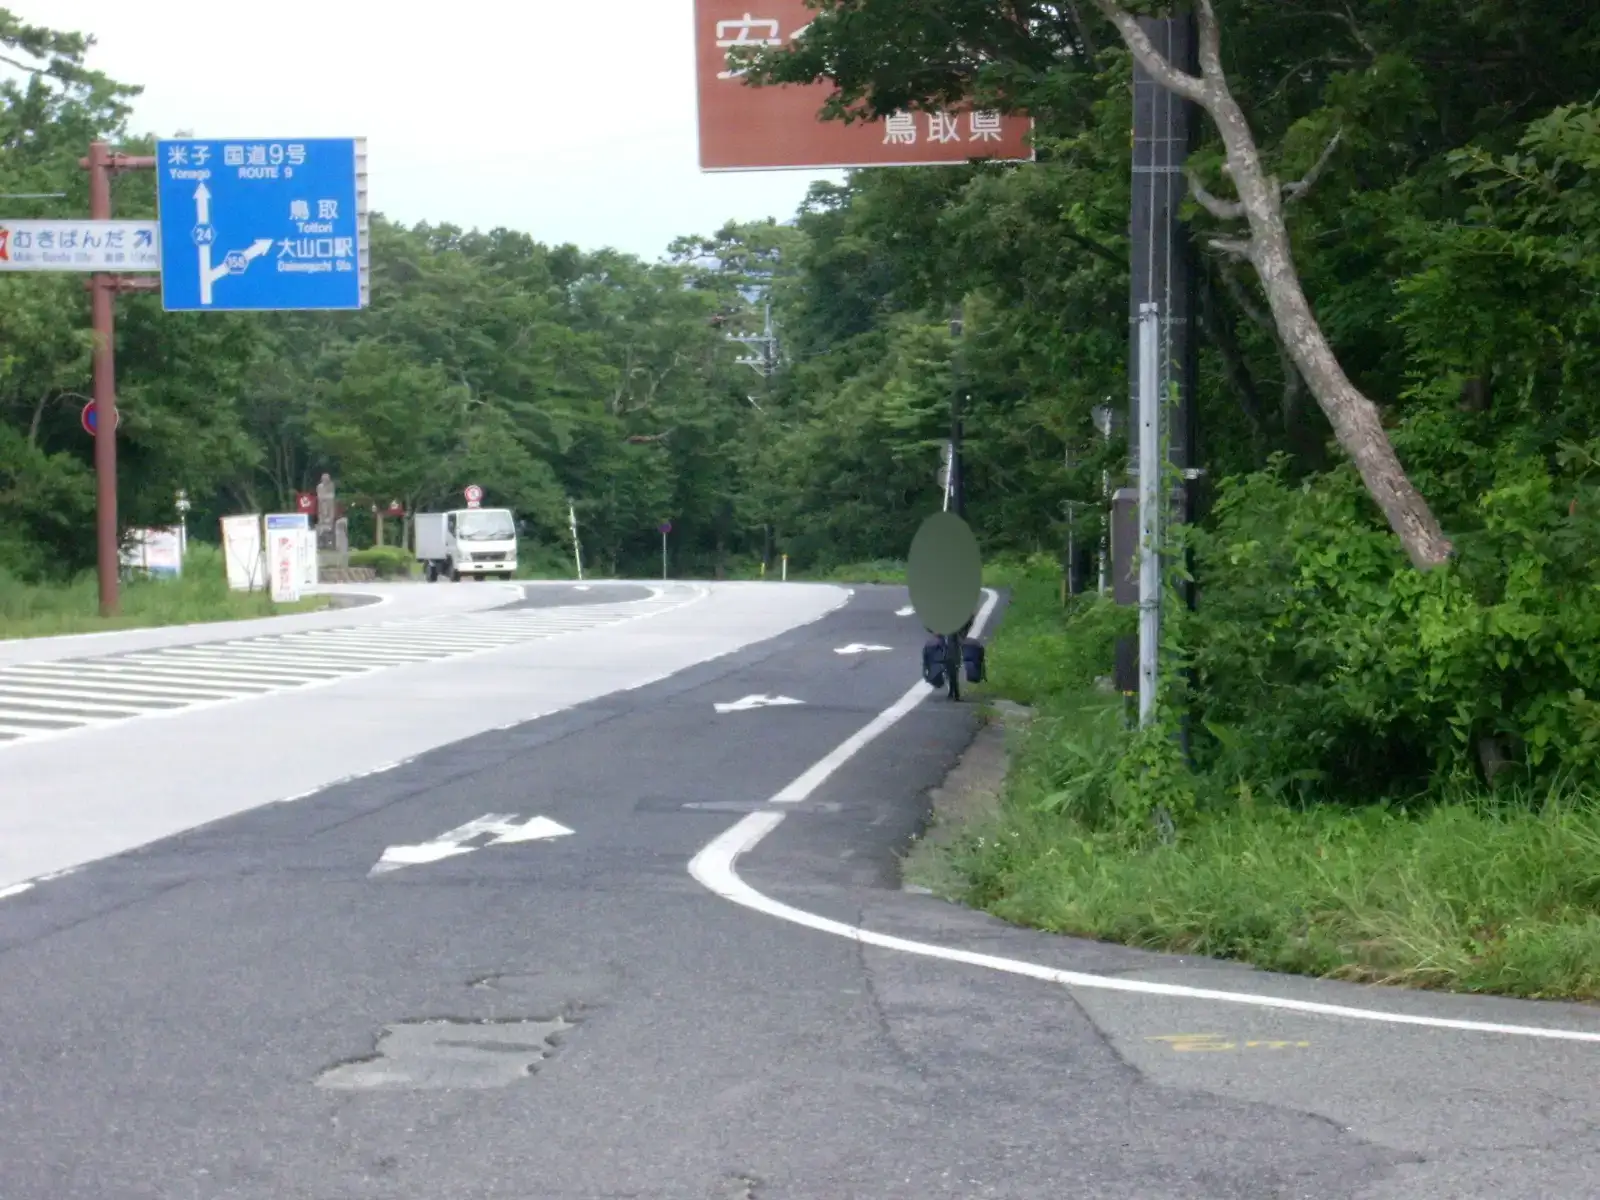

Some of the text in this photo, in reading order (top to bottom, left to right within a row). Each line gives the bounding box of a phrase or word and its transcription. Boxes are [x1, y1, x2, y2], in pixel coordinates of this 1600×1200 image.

[882, 108, 1002, 144] 鳥取県
[168, 143, 307, 166] 米子 国道9号
[238, 166, 293, 179] ROUTE 9
[289, 199, 339, 220] 鳥取
[196, 228, 213, 242] 24
[276, 237, 354, 258] 大山口駅
